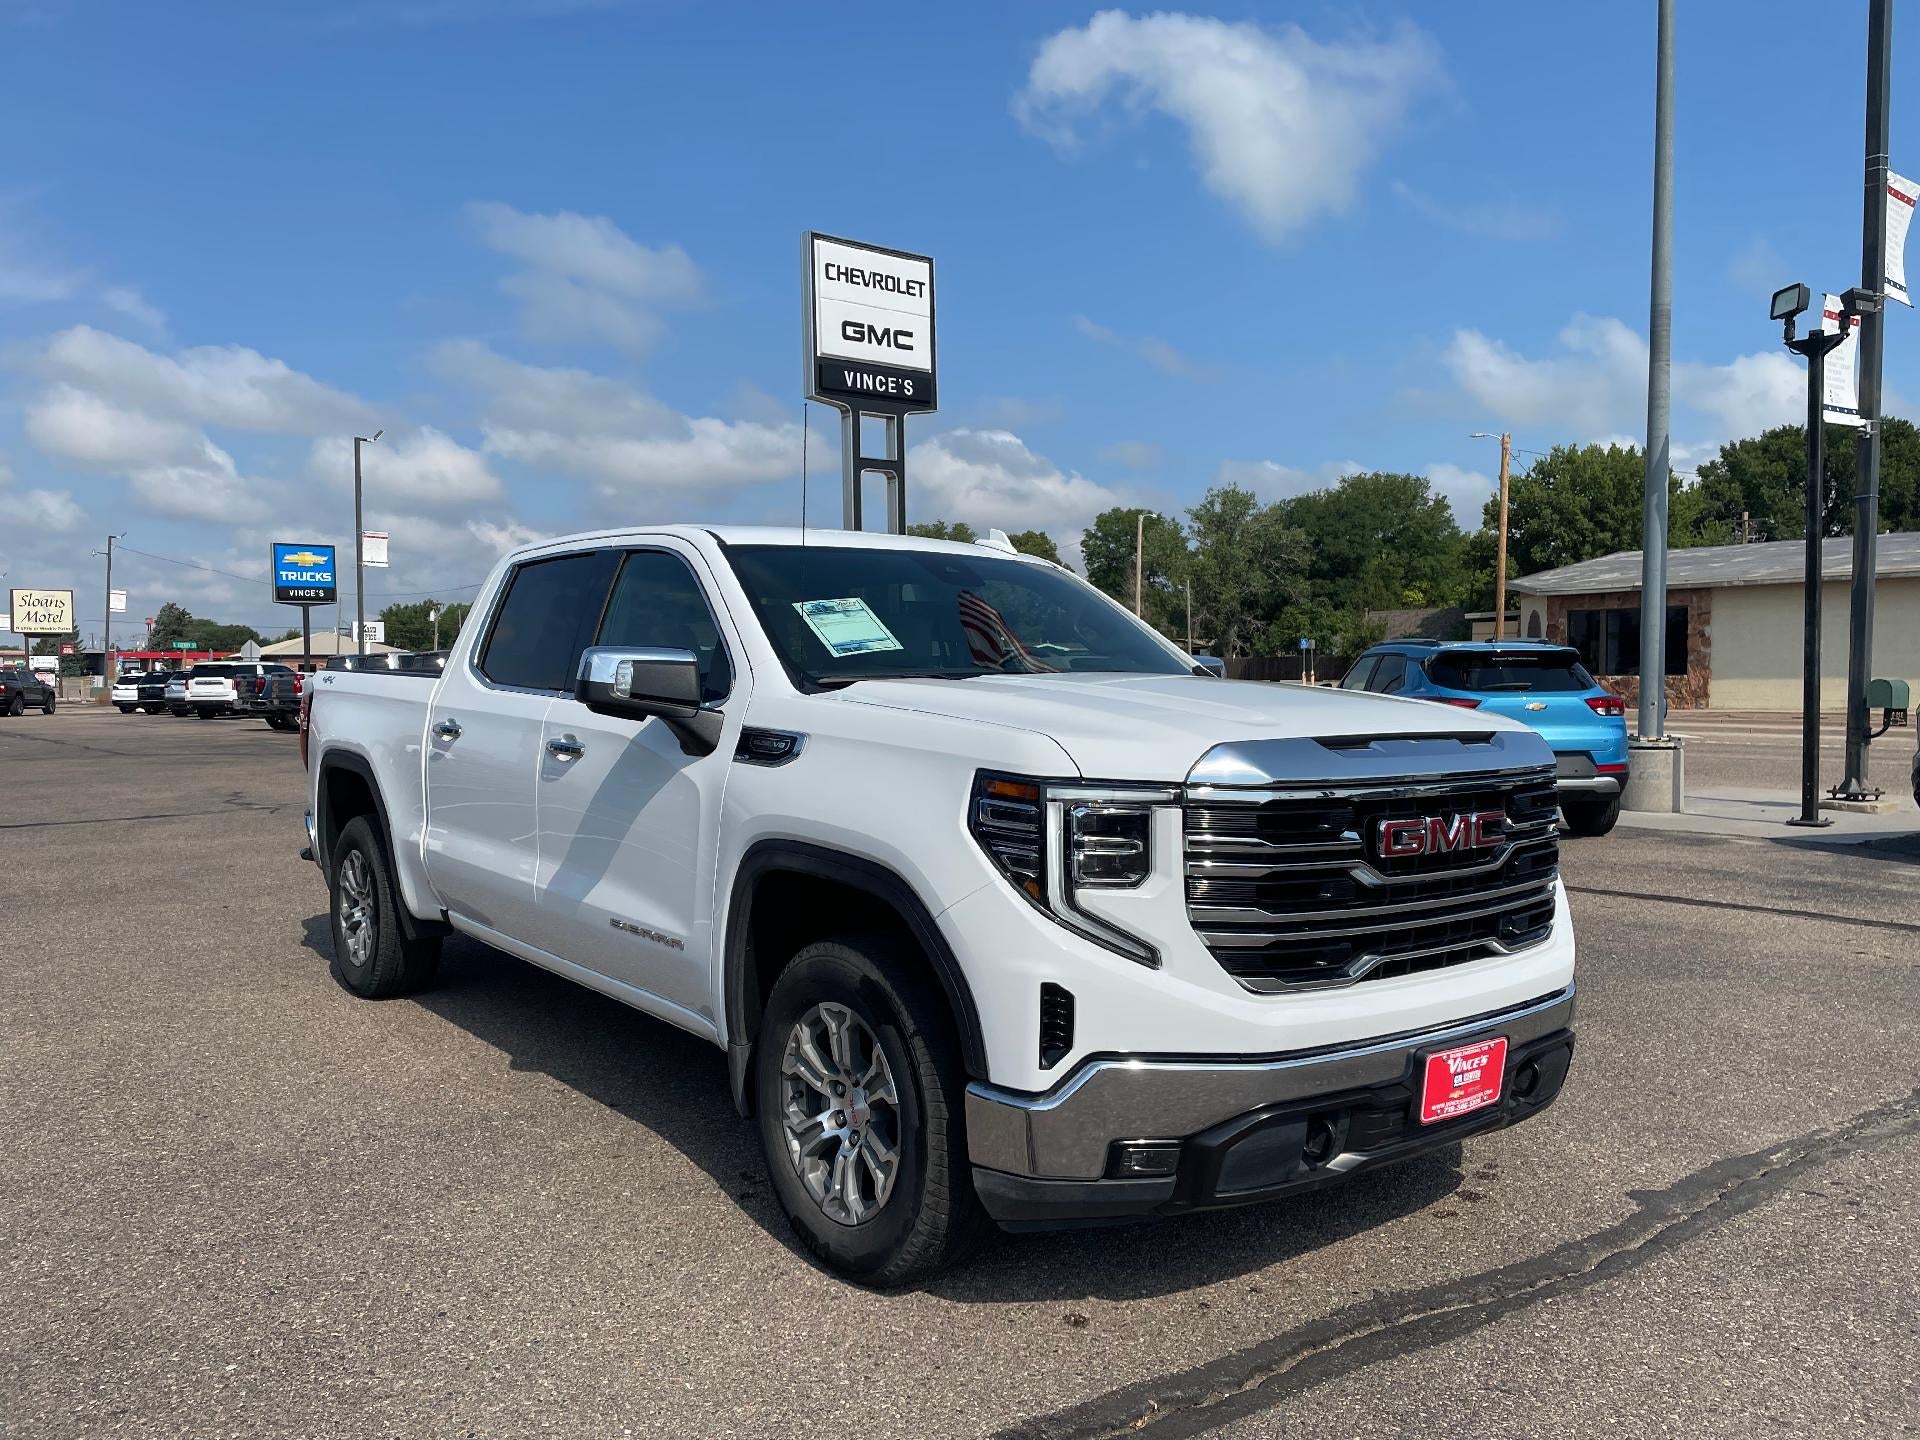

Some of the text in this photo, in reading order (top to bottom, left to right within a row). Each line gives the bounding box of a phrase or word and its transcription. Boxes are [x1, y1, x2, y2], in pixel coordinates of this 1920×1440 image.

[824, 262, 926, 299] CHEVROLET
[841, 319, 914, 351] GMC
[844, 370, 914, 396] VINCE'S
[279, 570, 332, 582] TRUCKS
[289, 589, 325, 597] VINCE'S
[20, 609, 64, 623] Motel
[1377, 810, 1507, 859] GMC
[609, 917, 685, 951] SIERRA
